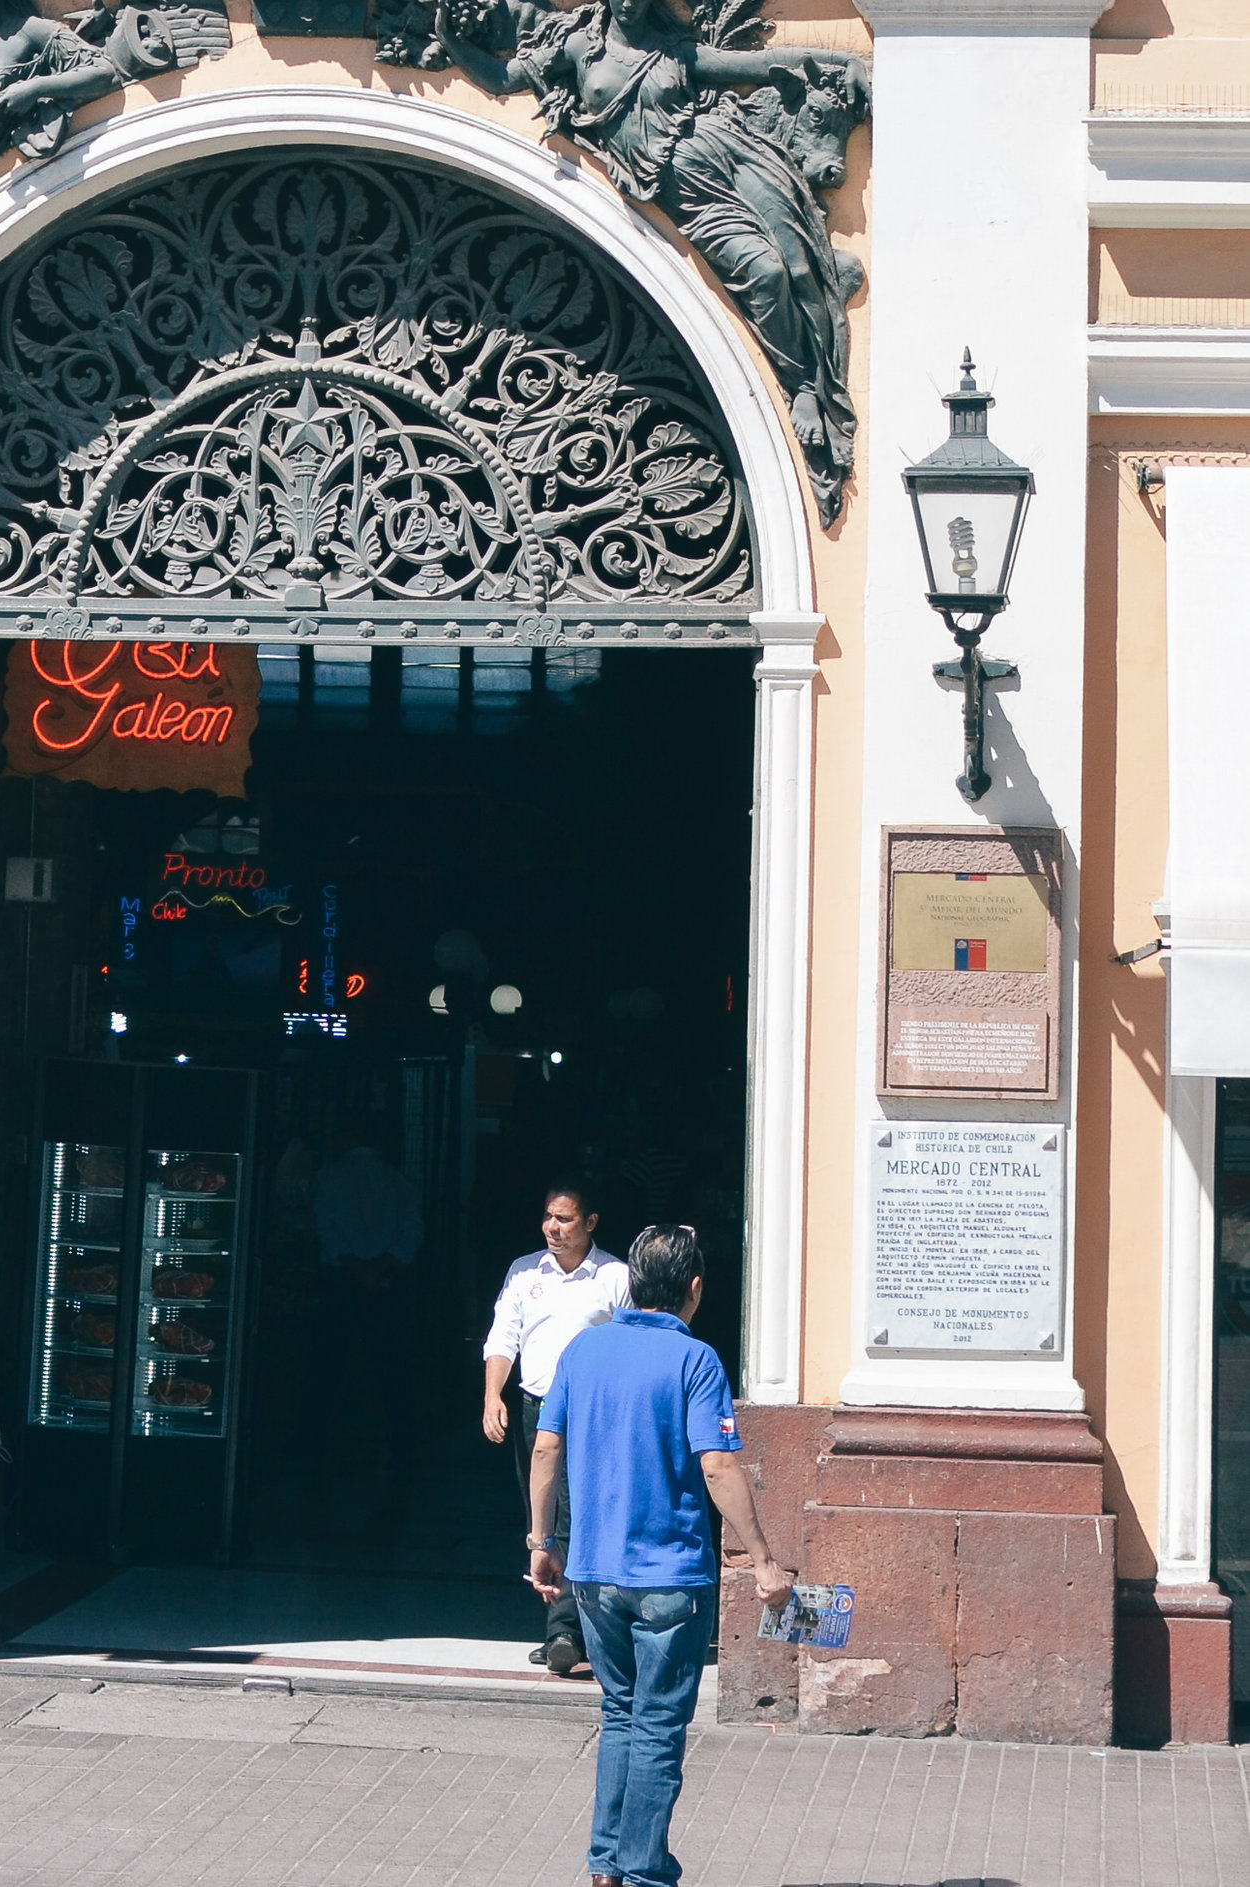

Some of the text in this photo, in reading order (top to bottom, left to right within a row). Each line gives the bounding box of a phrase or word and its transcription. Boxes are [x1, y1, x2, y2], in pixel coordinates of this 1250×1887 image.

[161, 853, 267, 888] Pronto
[152, 901, 188, 921] Chile
[898, 1131, 945, 1141] INSTITUTO
[948, 1132, 960, 1141] DE
[968, 1144, 981, 1153] DE
[985, 1145, 1013, 1154] CHILE
[886, 1160, 1042, 1177] MERCADO CENTRAL
[971, 1179, 992, 1187] 2012
[897, 1308, 1029, 1319] CONSEJO DE MONUMENTOS
[933, 1321, 993, 1330] NACIONALES
